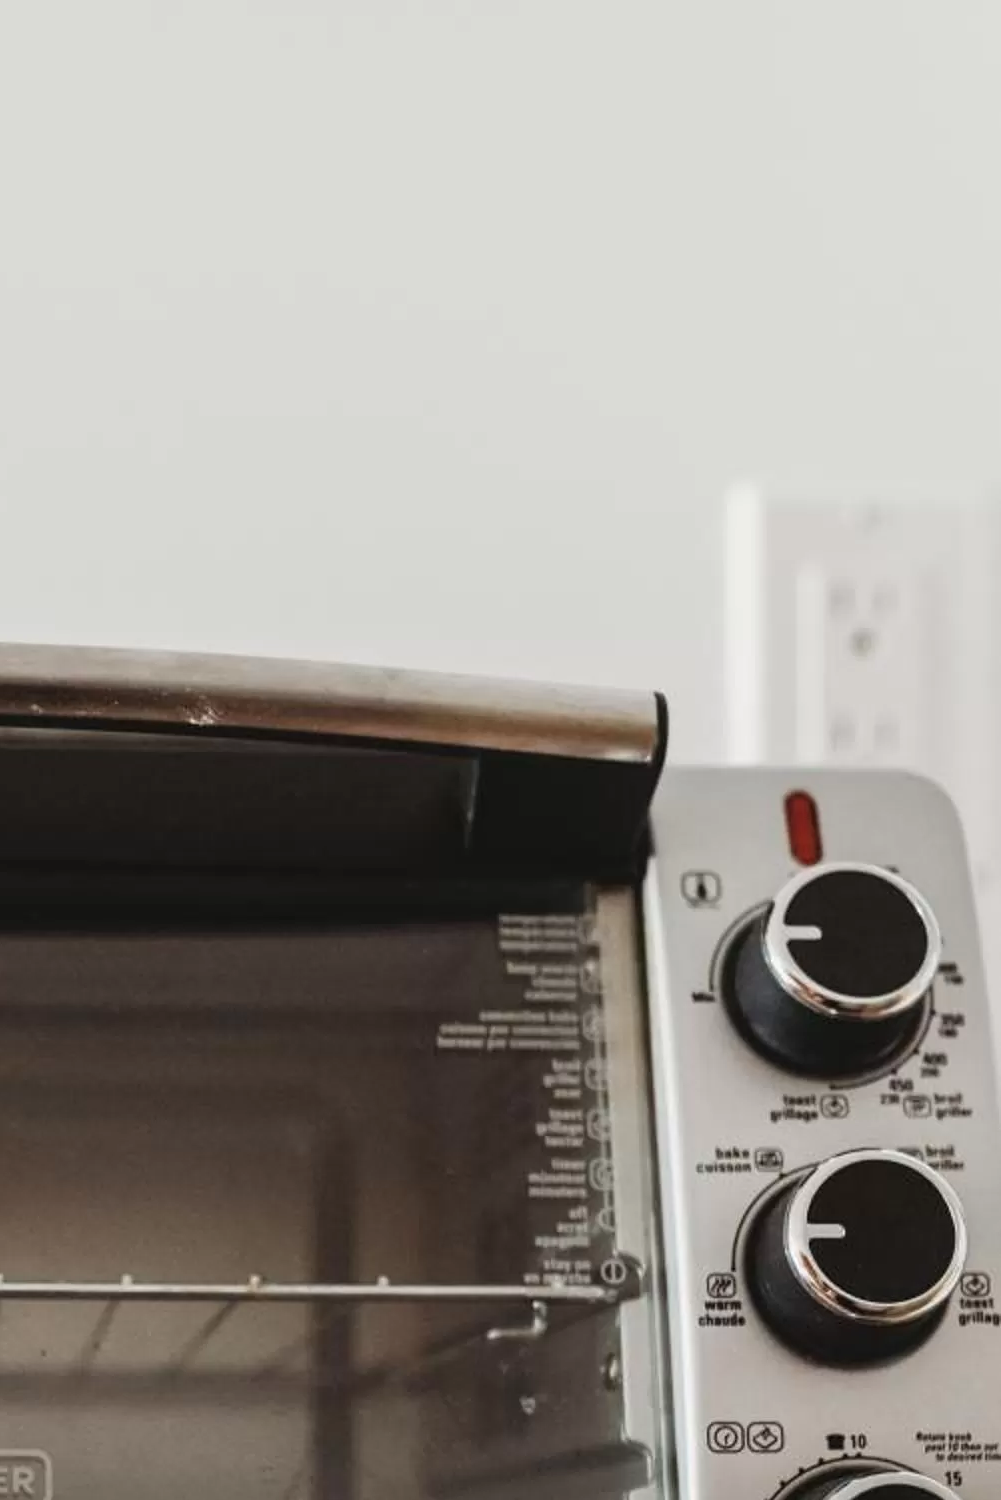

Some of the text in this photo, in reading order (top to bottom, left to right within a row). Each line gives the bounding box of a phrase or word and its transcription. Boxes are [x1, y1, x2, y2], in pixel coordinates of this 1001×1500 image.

[783, 1094, 816, 1106] toast
[770, 1108, 818, 1122] grillage
[716, 1147, 749, 1159] bake
[696, 1160, 751, 1173] cuisson
[929, 1158, 964, 1171] riller
[704, 1299, 742, 1311] warm
[960, 1298, 994, 1309] toast
[698, 1313, 746, 1326] chaude
[959, 1311, 1001, 1326] grillag
[850, 1434, 867, 1449] 10
[945, 1470, 963, 1487] 15
